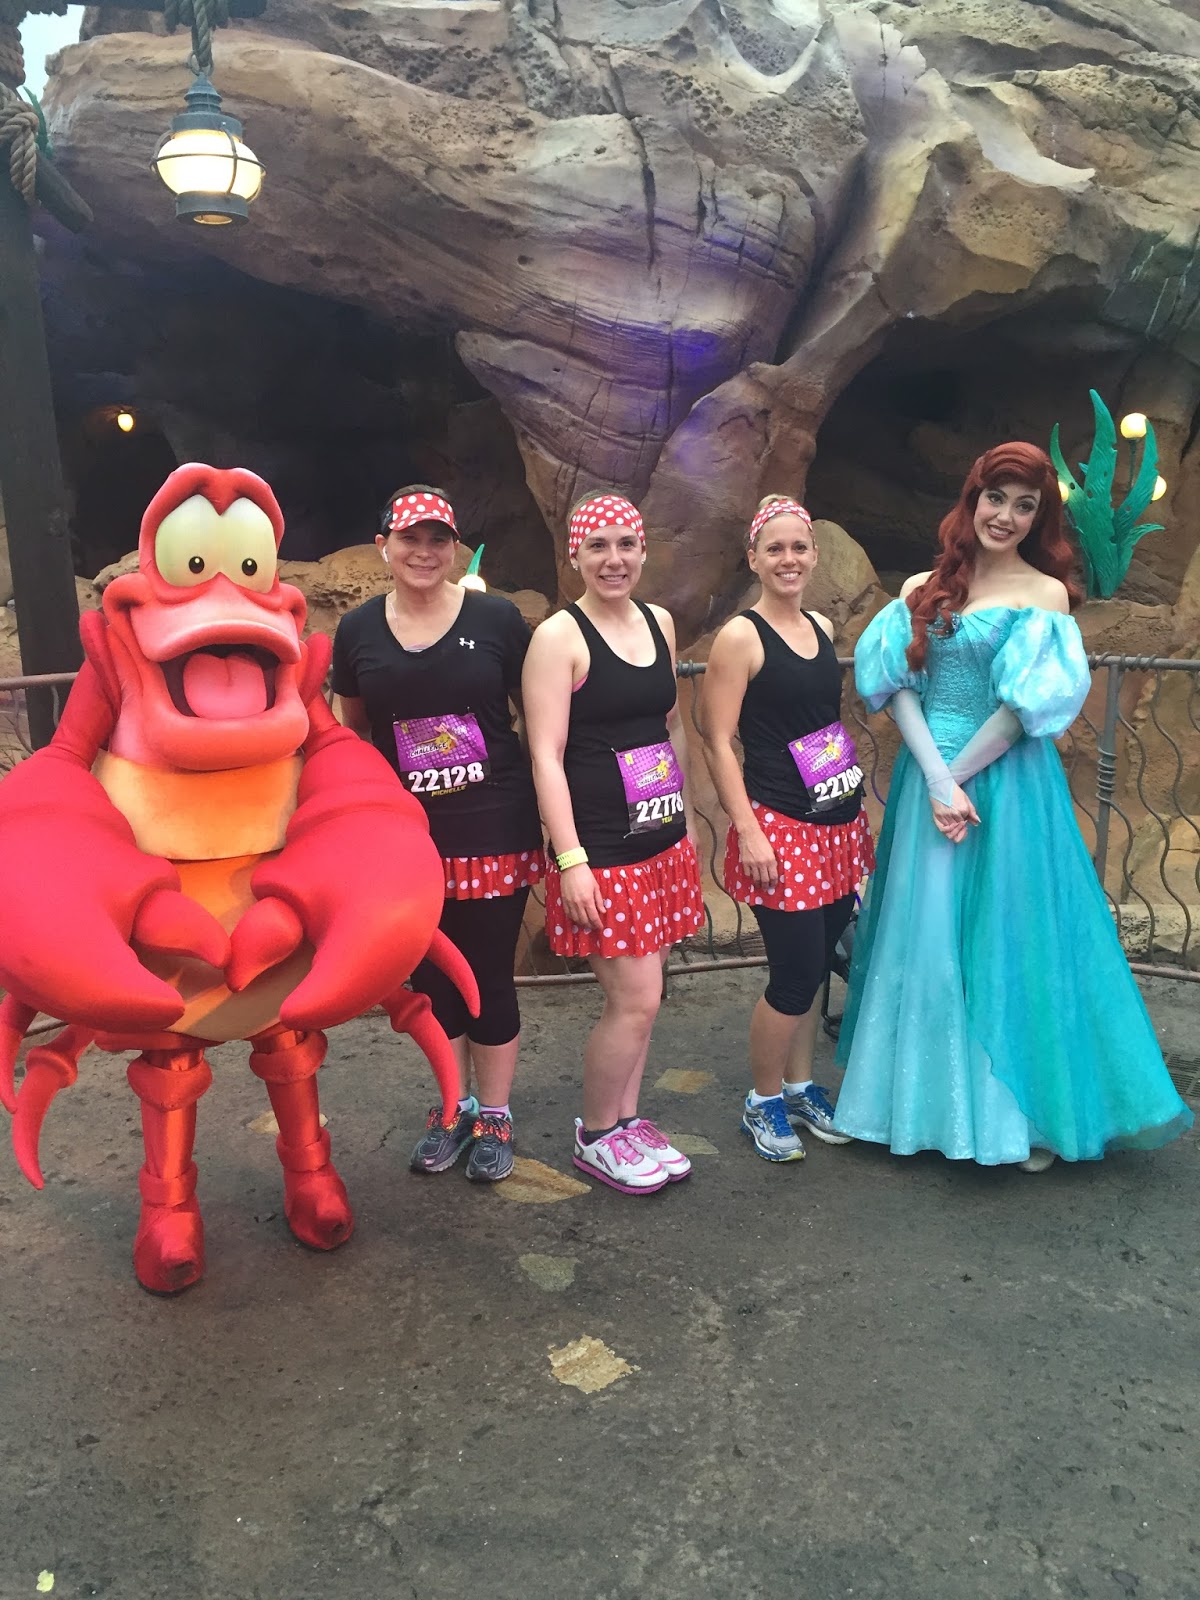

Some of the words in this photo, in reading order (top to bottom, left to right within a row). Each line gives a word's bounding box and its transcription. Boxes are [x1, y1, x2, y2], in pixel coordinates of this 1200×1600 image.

[411, 743, 448, 757] CHALLENGE
[408, 762, 484, 792] 22128
[431, 785, 466, 796] MICHELLE
[636, 791, 684, 823] 22778
